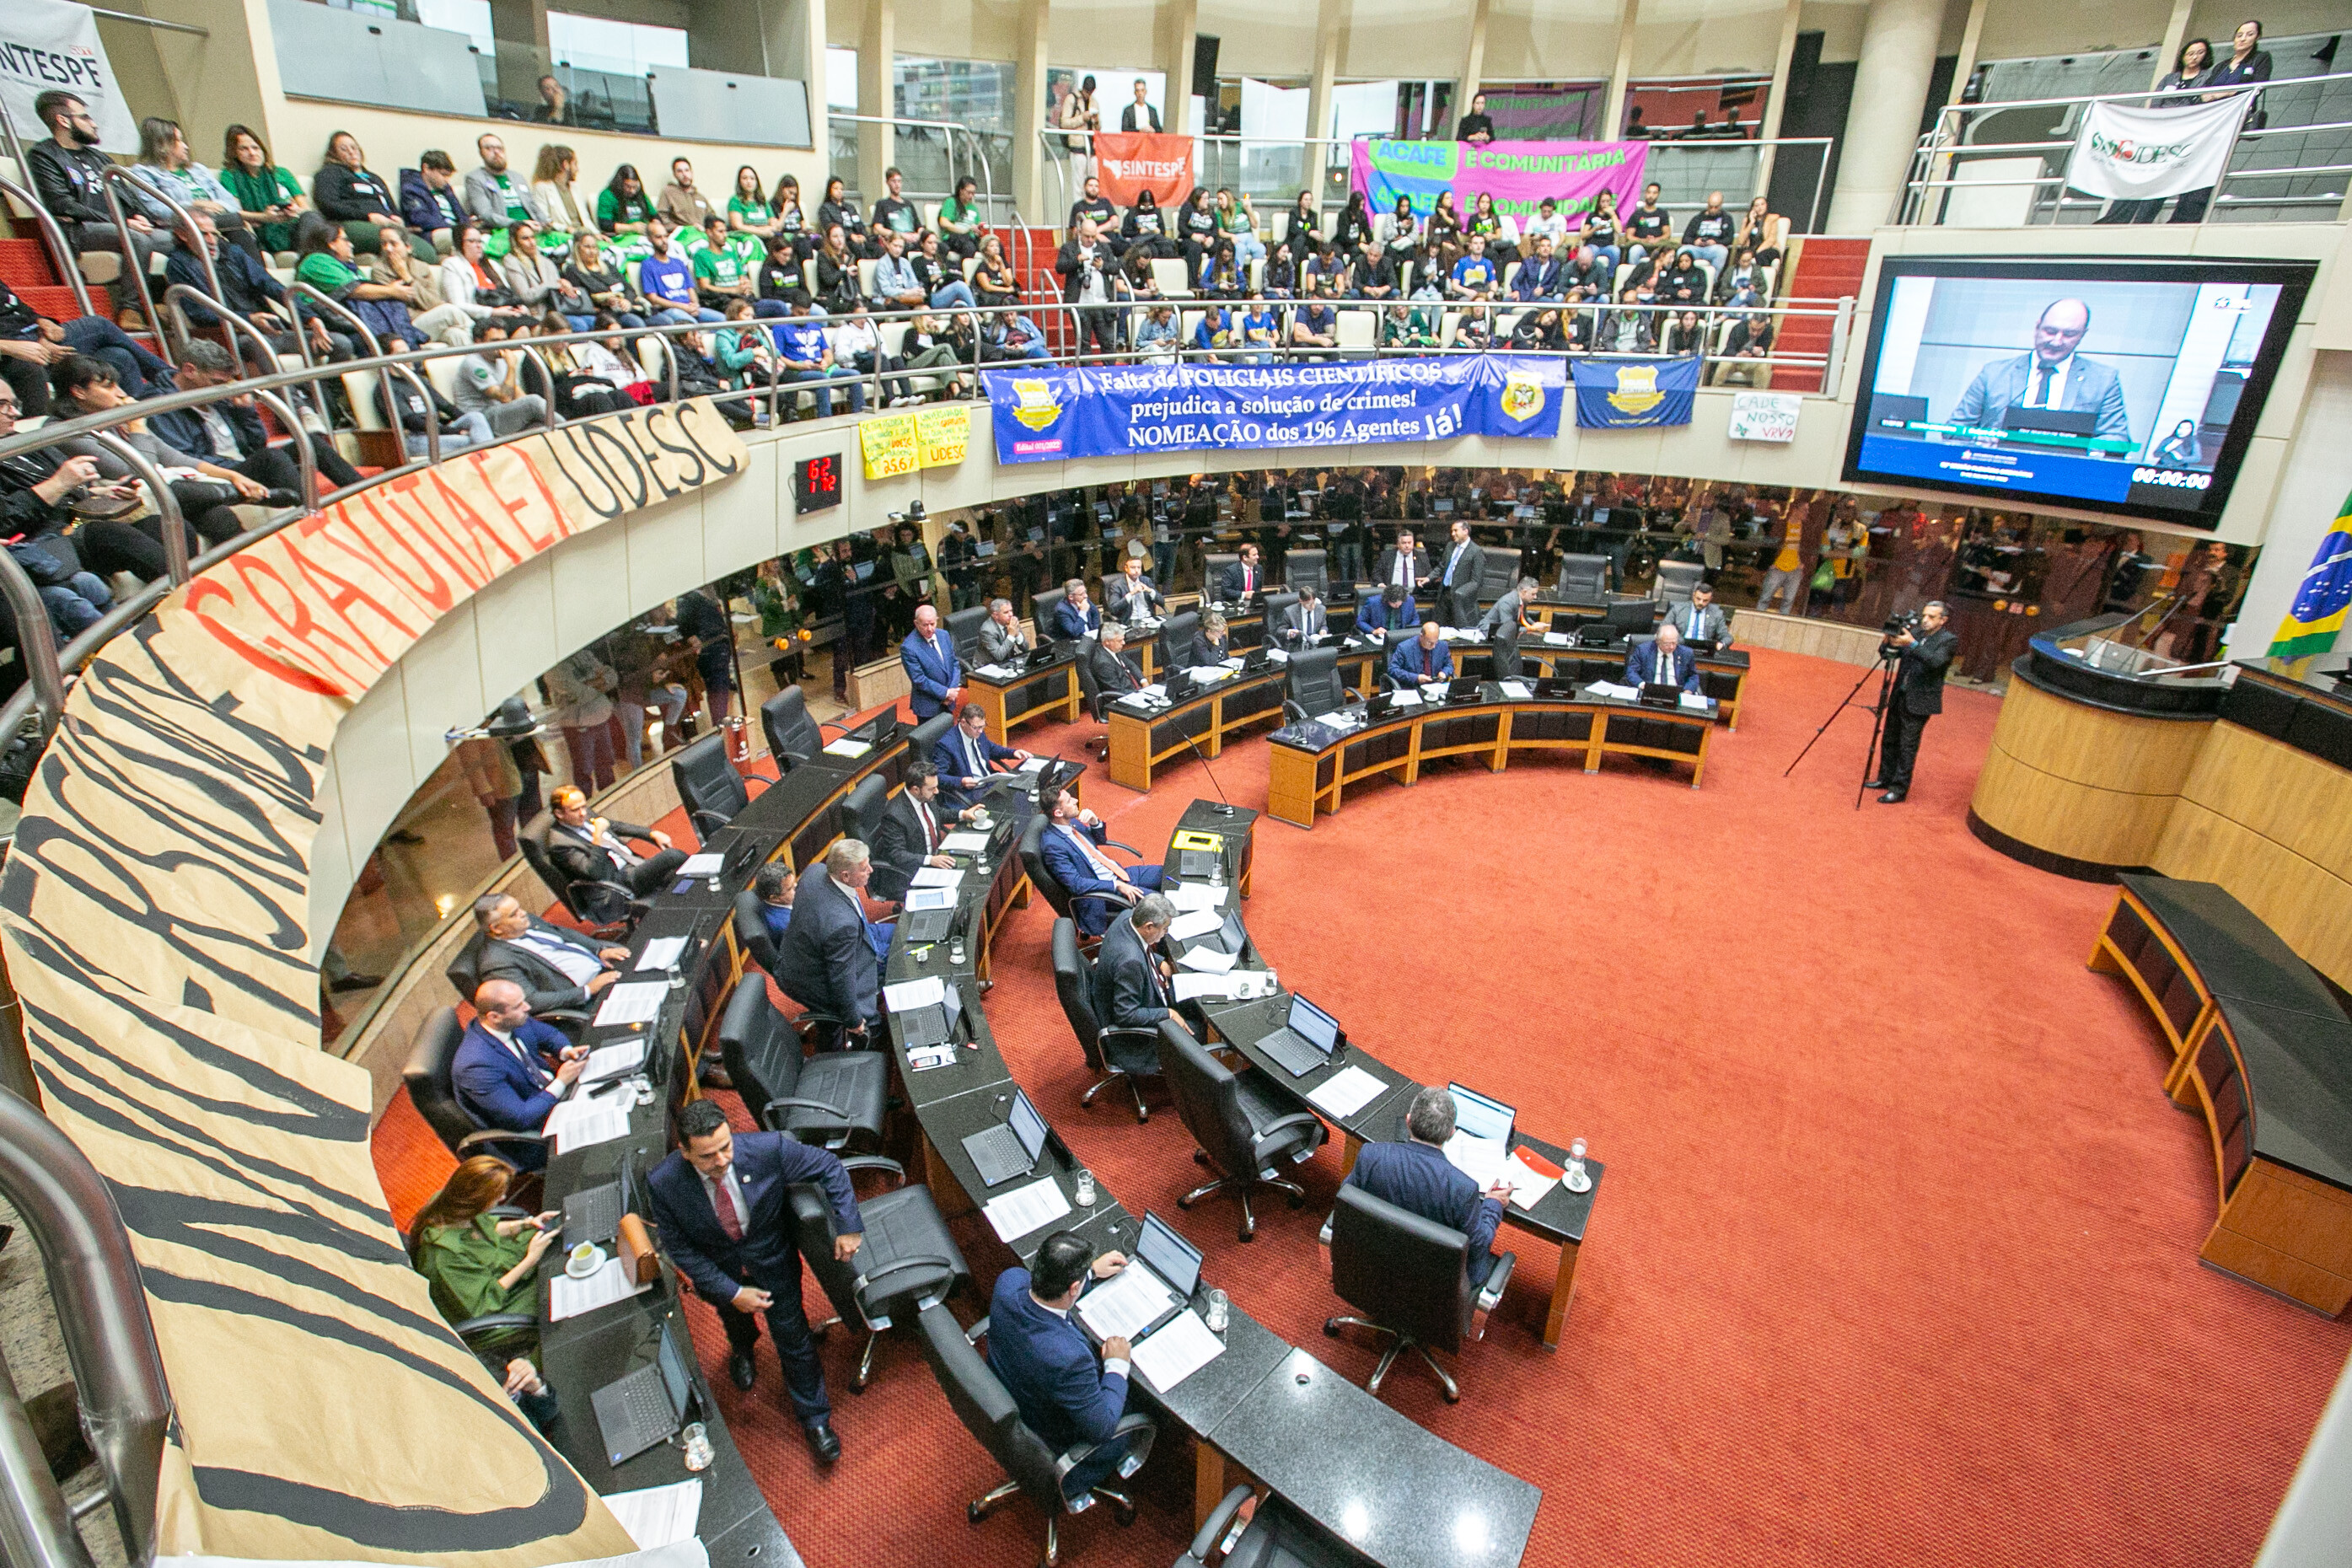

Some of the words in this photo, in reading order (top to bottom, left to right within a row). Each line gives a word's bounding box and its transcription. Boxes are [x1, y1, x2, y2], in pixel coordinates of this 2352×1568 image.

[1122, 159, 1186, 177] SINTESPE
[1377, 141, 1447, 167] ACAFE
[1465, 147, 1478, 168] É
[1479, 147, 1627, 174] COMUNITÁRIA
[1463, 191, 1478, 213] É
[1099, 369, 1150, 390] Falta
[1154, 368, 1179, 388] de
[1181, 368, 1295, 388] POLICIAIS
[1298, 362, 1443, 386] CIENTÍFICOS
[1130, 395, 1222, 423] prejudica
[1225, 401, 1237, 415] a
[1241, 395, 1315, 418] solução
[1319, 392, 1343, 412] de
[1346, 389, 1417, 410] crimes!
[1747, 412, 1795, 426] NOSSO
[1127, 419, 1261, 447] NOMEAÇÃO
[1265, 422, 1299, 441] dos
[1303, 421, 1336, 440] 196
[1340, 418, 1420, 443] Agentes
[1424, 403, 1463, 442] Já!
[541, 402, 738, 518] UDESC
[930, 444, 964, 462] UDESC
[2132, 466, 2212, 491] 00:00:00
